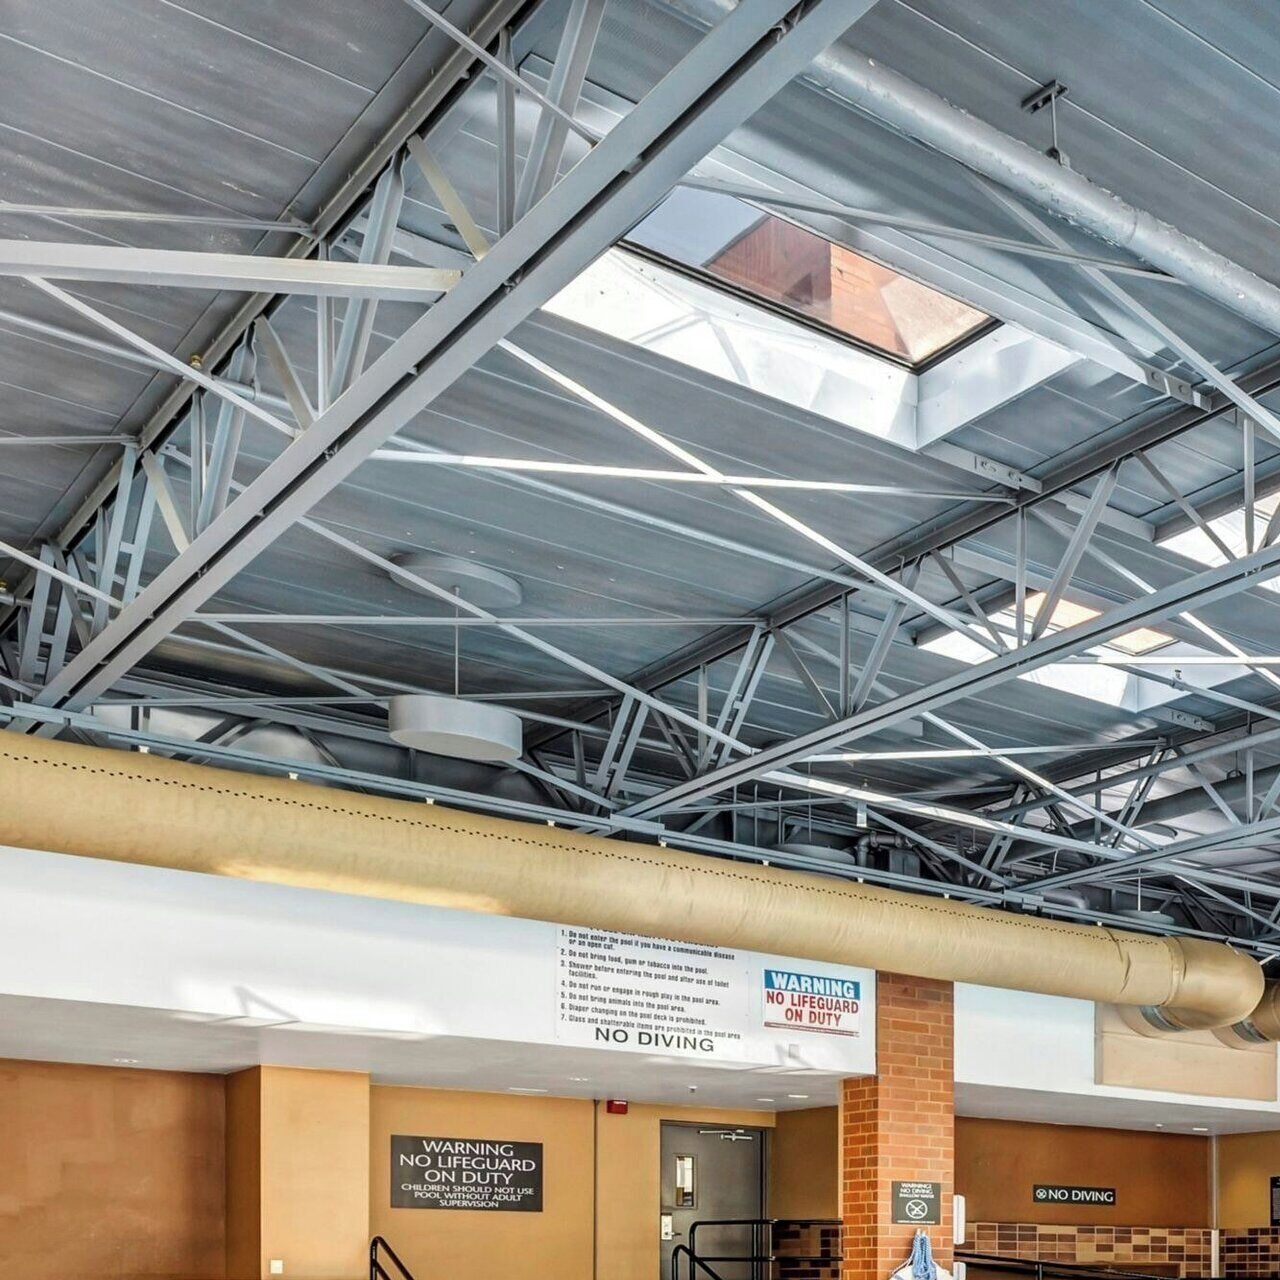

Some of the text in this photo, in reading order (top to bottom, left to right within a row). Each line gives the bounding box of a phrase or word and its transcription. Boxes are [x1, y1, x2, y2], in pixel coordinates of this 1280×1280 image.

[568, 930, 576, 939] Do
[578, 932, 588, 941] not
[590, 933, 607, 943] enter
[608, 936, 618, 945] the
[620, 938, 632, 948] pool
[634, 940, 638, 948] if
[640, 942, 650, 951] you
[652, 942, 665, 952] have
[673, 945, 712, 958] communicable
[713, 951, 735, 961] disease
[587, 941, 601, 951] open
[568, 949, 576, 958] Do
[578, 950, 588, 959] not
[590, 952, 606, 963] bring
[624, 958, 636, 967] gum
[638, 959, 645, 967] or
[647, 959, 669, 970] tobacco
[671, 962, 682, 971] into
[684, 964, 693, 973] the
[568, 961, 592, 972] Shower
[594, 964, 614, 974] before
[616, 967, 641, 979] entering
[643, 970, 652, 979] the
[654, 972, 666, 982] pool
[667, 973, 678, 982] and
[679, 975, 694, 984] after
[695, 978, 705, 986] use
[707, 978, 713, 987] of
[714, 979, 729, 989] toilet
[568, 981, 576, 989] Do
[578, 982, 588, 991] not
[590, 984, 601, 992] run
[611, 987, 633, 997] engage
[634, 988, 640, 997] in
[642, 989, 659, 1000] rough
[660, 992, 672, 1002] play
[674, 993, 679, 1001] in
[681, 994, 690, 1002] the
[692, 995, 703, 1006] pool
[771, 972, 855, 998] WARNING
[568, 992, 576, 1001] Do
[578, 993, 588, 1002] not
[590, 995, 606, 1005] bring
[608, 997, 630, 1007] animals
[632, 999, 644, 1008] into
[645, 1001, 655, 1009] the
[656, 1002, 669, 1012] pool
[766, 990, 859, 1014] NO LIFEGUARD
[568, 1003, 589, 1014] Diaper
[590, 1006, 617, 1018] changing
[628, 1010, 637, 1018] the
[639, 1011, 651, 1021] pool
[653, 1012, 666, 1021] deck
[668, 1014, 674, 1022] is
[785, 1008, 842, 1027] ON DUTY
[595, 1027, 714, 1052] NO DIVING
[422, 1140, 514, 1157] WARNING
[400, 1153, 536, 1172] NO LIFEGUARD
[424, 1169, 514, 1185] ON DUTY
[401, 1183, 450, 1192] CHILDREN
[452, 1185, 492, 1194] SHOULD
[414, 1191, 522, 1202] POOL WITHOUT ADULT
[1048, 1189, 1114, 1202] NO DIVING
[439, 1199, 499, 1208] SUPERVISION
